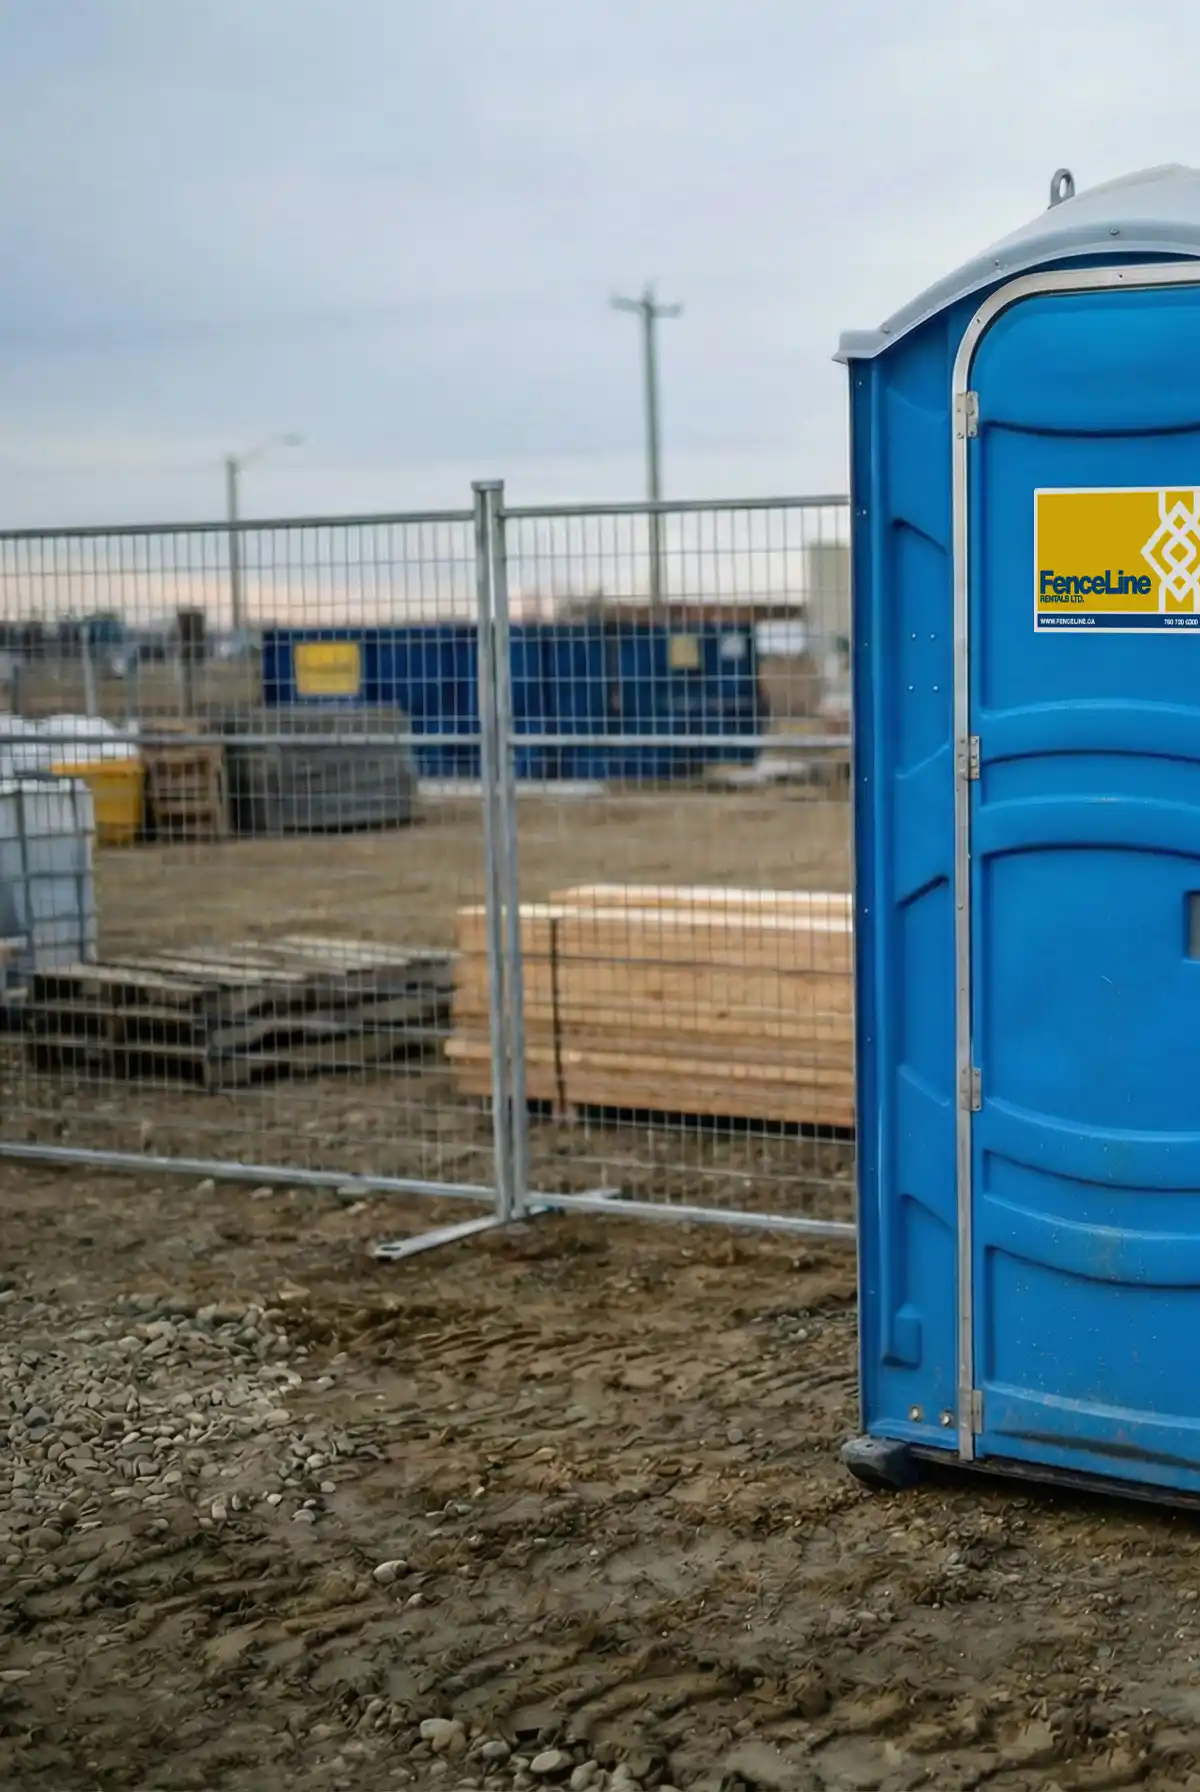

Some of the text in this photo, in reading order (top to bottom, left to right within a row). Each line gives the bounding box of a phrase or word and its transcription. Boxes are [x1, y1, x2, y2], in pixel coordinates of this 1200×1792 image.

[1040, 570, 1151, 595] FenceLine
[1040, 595, 1084, 603] RENTALS LTD.
